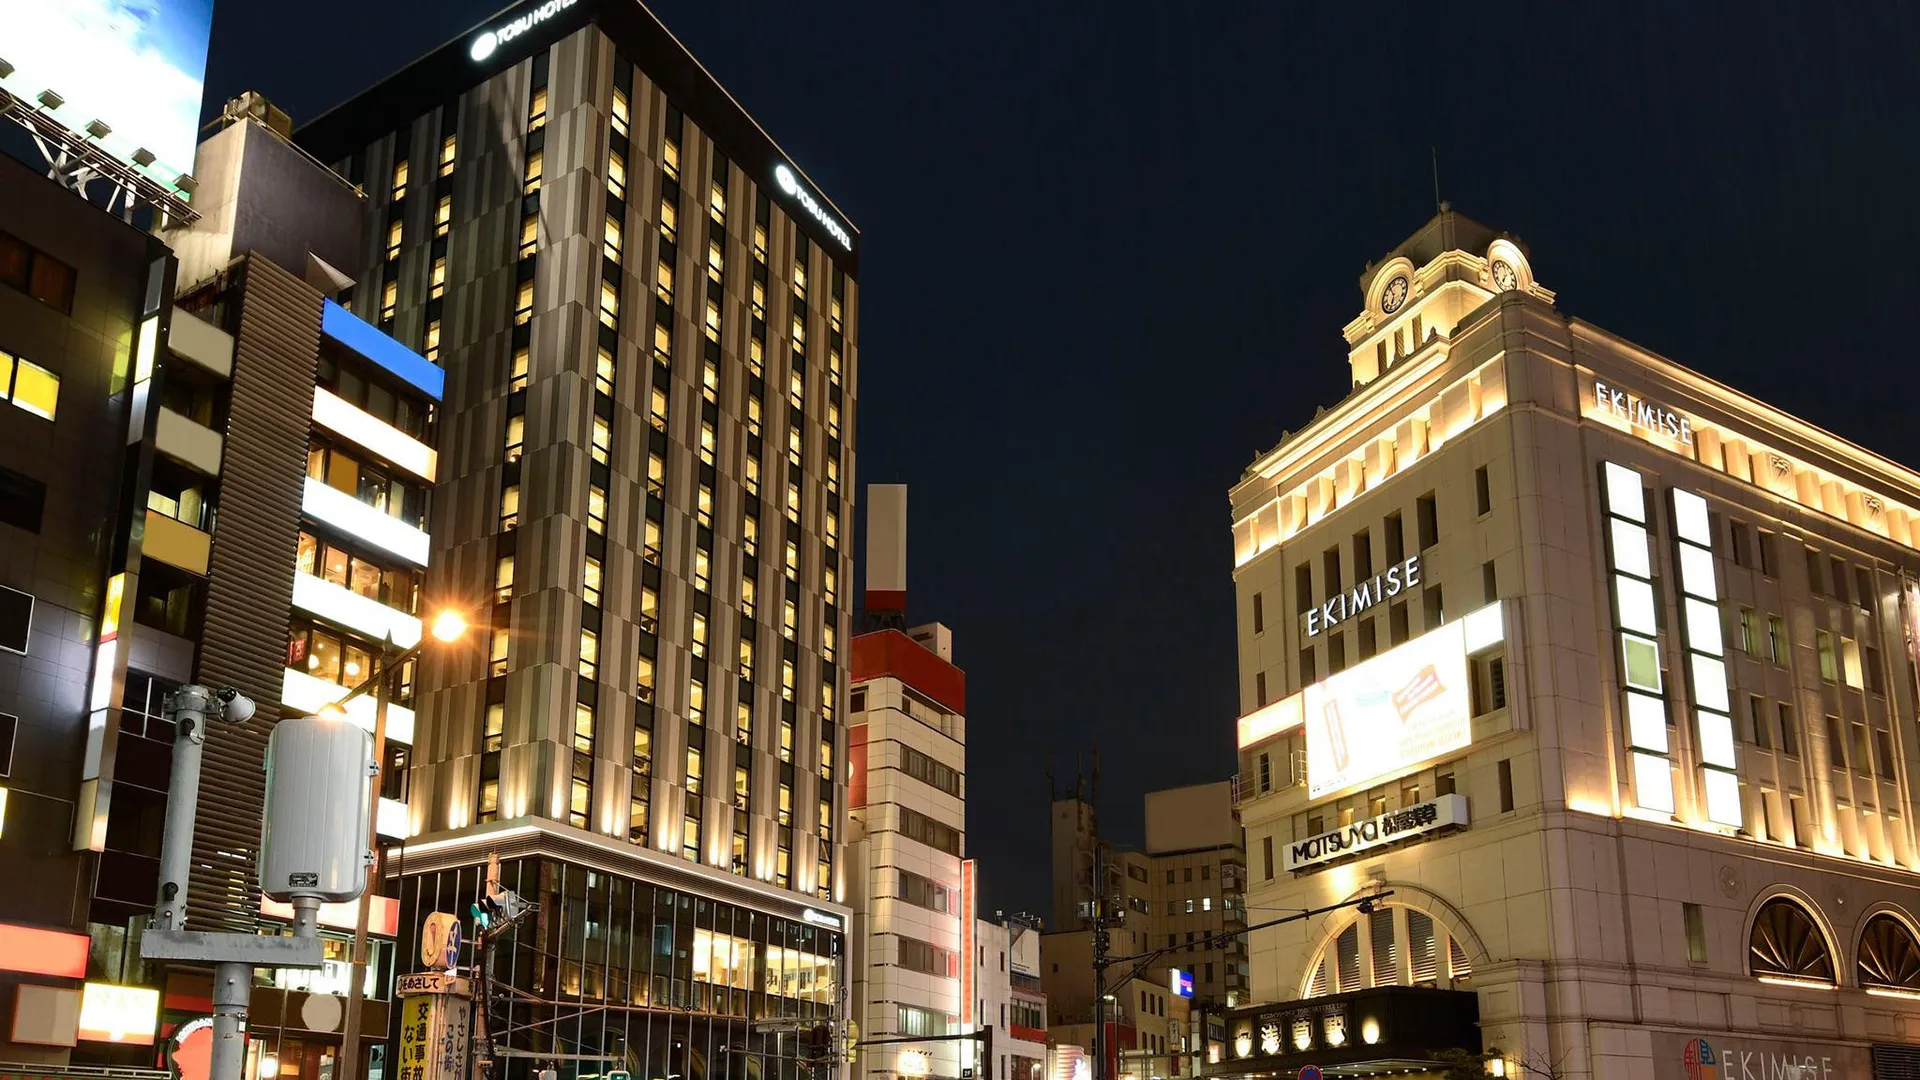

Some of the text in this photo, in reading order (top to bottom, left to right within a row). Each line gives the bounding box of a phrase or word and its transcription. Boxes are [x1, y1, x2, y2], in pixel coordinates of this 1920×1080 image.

[496, 0, 577, 45] TOBU HOTE
[796, 184, 852, 251] TOBU HOTEL
[1595, 382, 1693, 445] EKIMISE
[1307, 556, 1420, 637] EKIMISE
[1382, 803, 1437, 837] 松屋浅草
[413, 1002, 429, 1080] 交通事故
